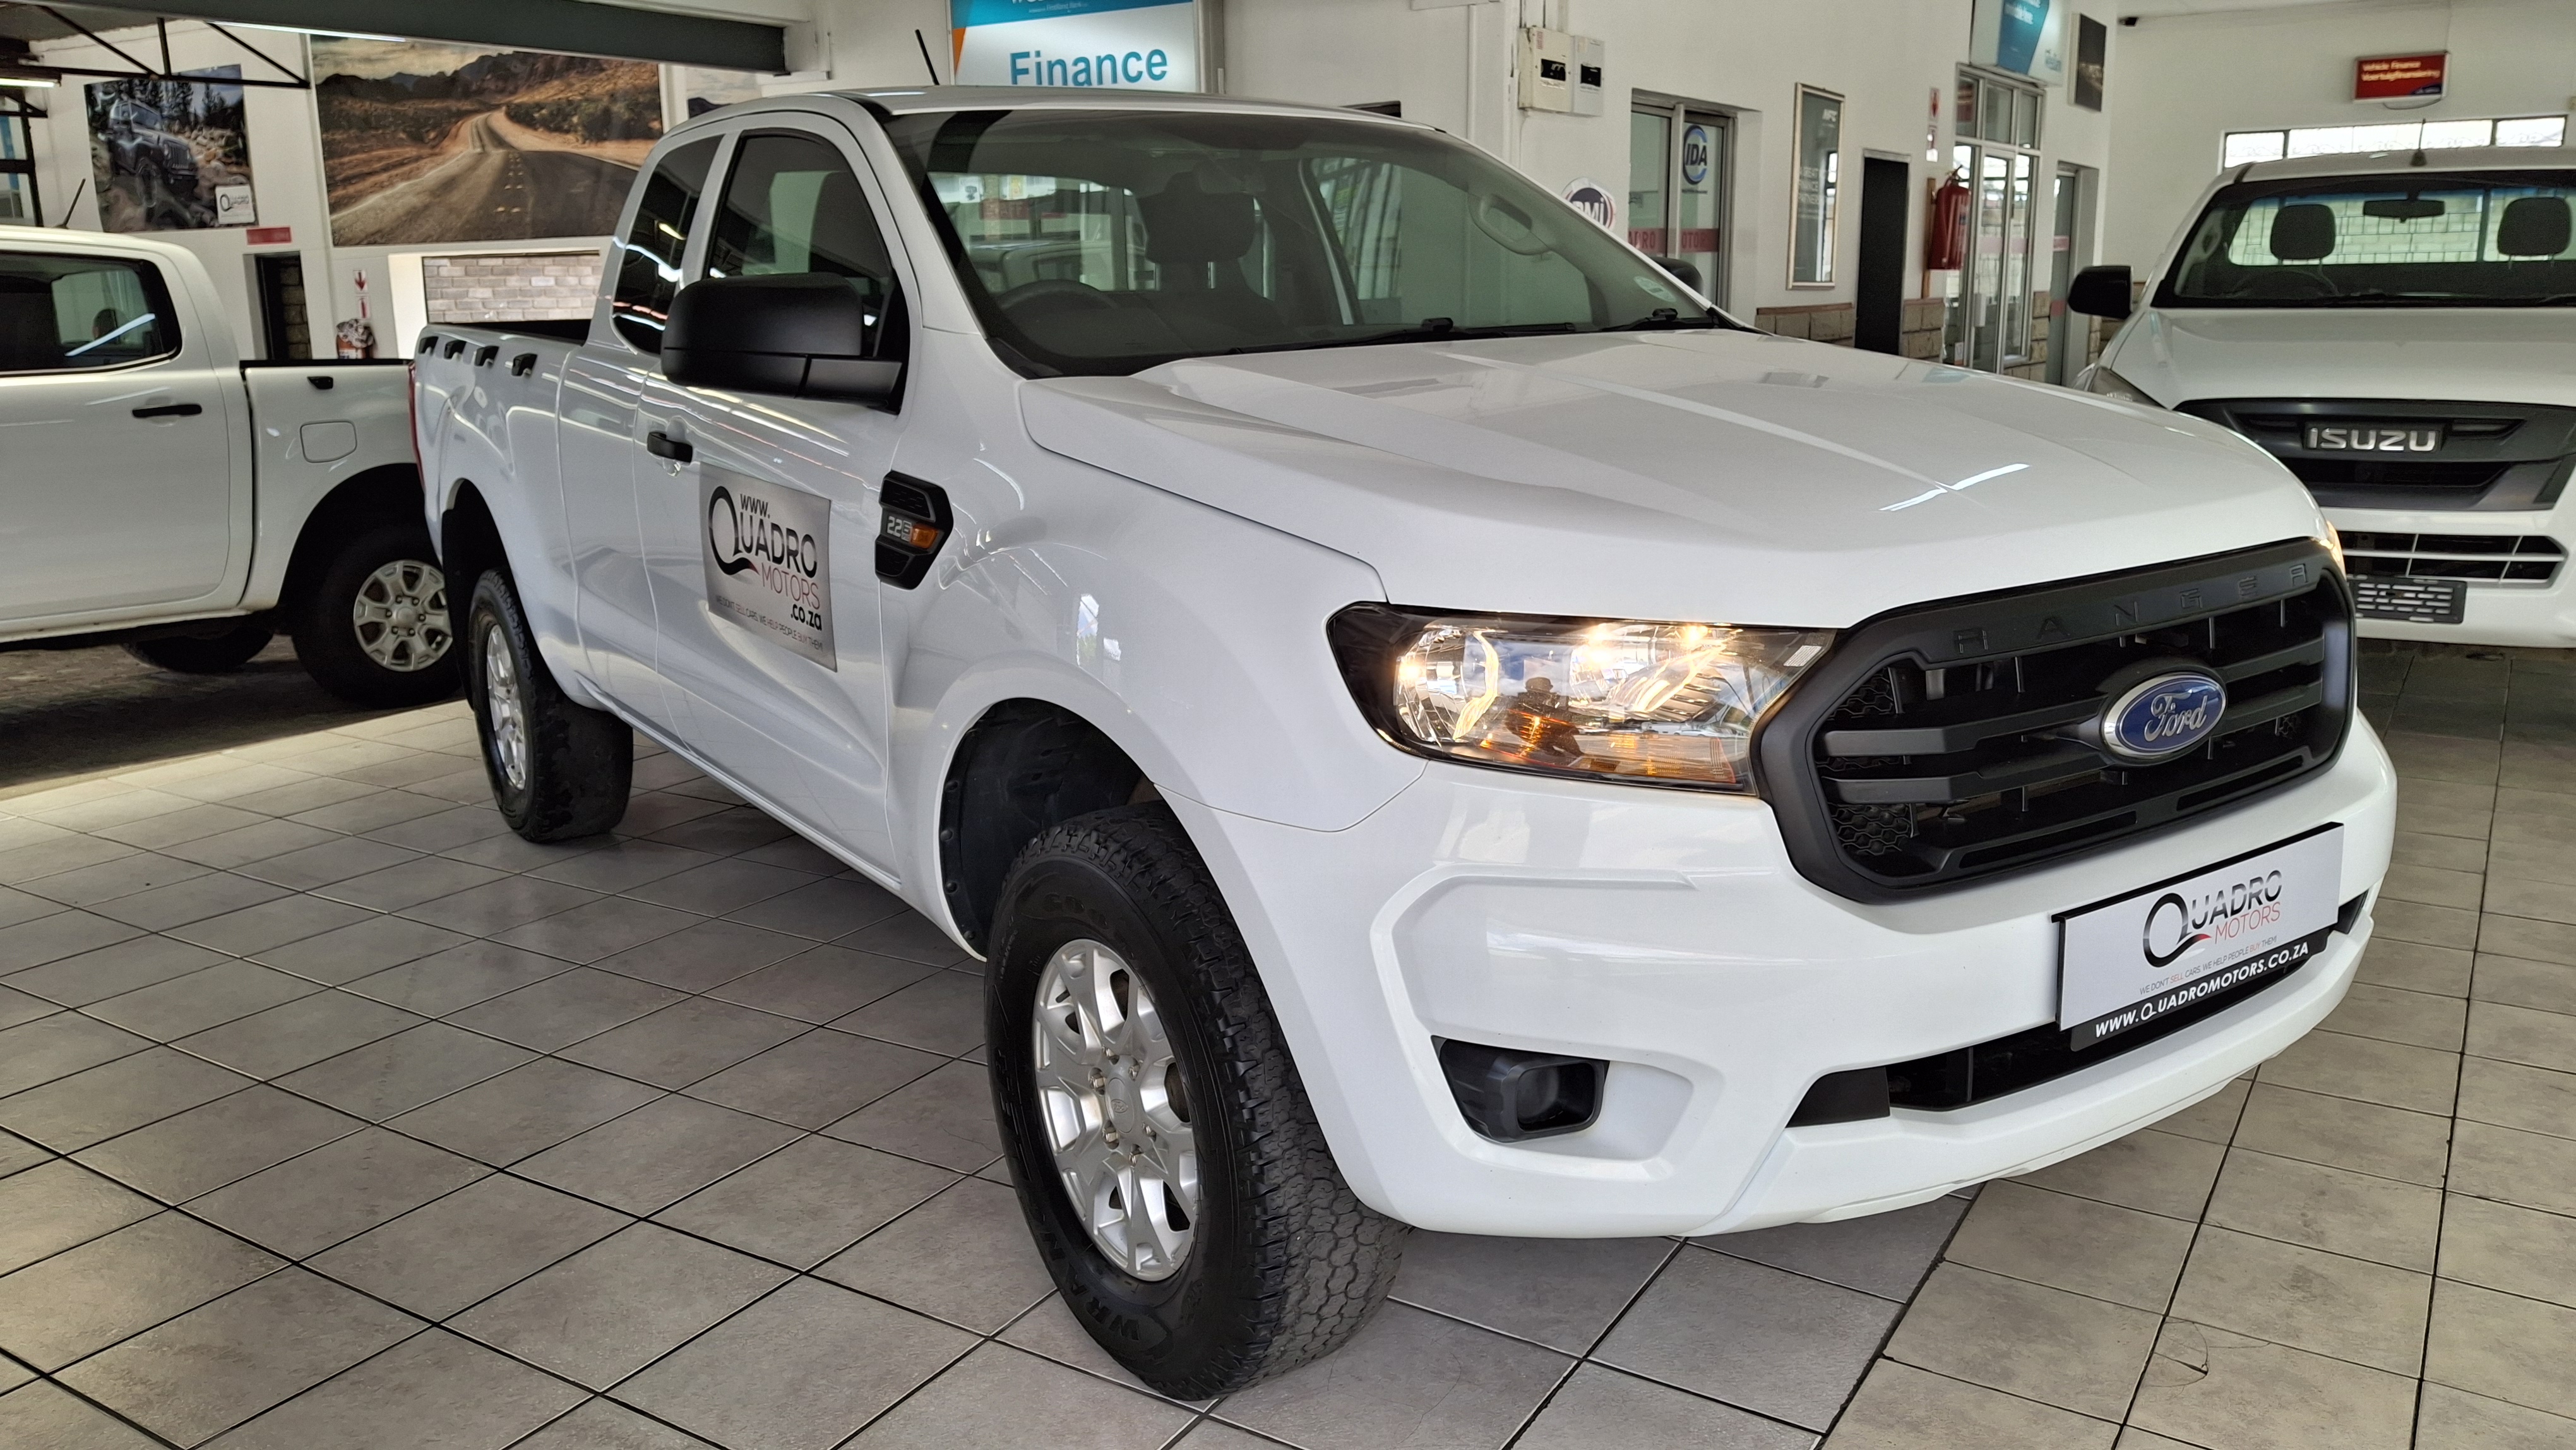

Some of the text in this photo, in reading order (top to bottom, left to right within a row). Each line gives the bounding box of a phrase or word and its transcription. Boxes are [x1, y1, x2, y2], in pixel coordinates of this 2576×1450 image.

[1010, 49, 1167, 87] Finance
[1686, 143, 1707, 166] IDA
[2308, 428, 2436, 452] ISUZU
[708, 486, 817, 578] QUADRO
[761, 562, 820, 610] MOTORS
[1955, 563, 2308, 654] RANGER
[790, 604, 822, 631] .co.za
[2144, 688, 2208, 742] Ford
[2143, 870, 2282, 968] QUADRO
[2215, 902, 2281, 944] MOTORS
[2096, 942, 2308, 1038] WWW.QUADROMOTORS.CO.ZA
[2140, 985, 2150, 995] WE
[2151, 977, 2170, 991] DON'T
[2170, 973, 2183, 984] SELL
[2203, 962, 2212, 971] WE
[2213, 956, 2227, 967] HELP
[2228, 947, 2249, 961] PEOPLE
[2250, 943, 2261, 952] BUY
